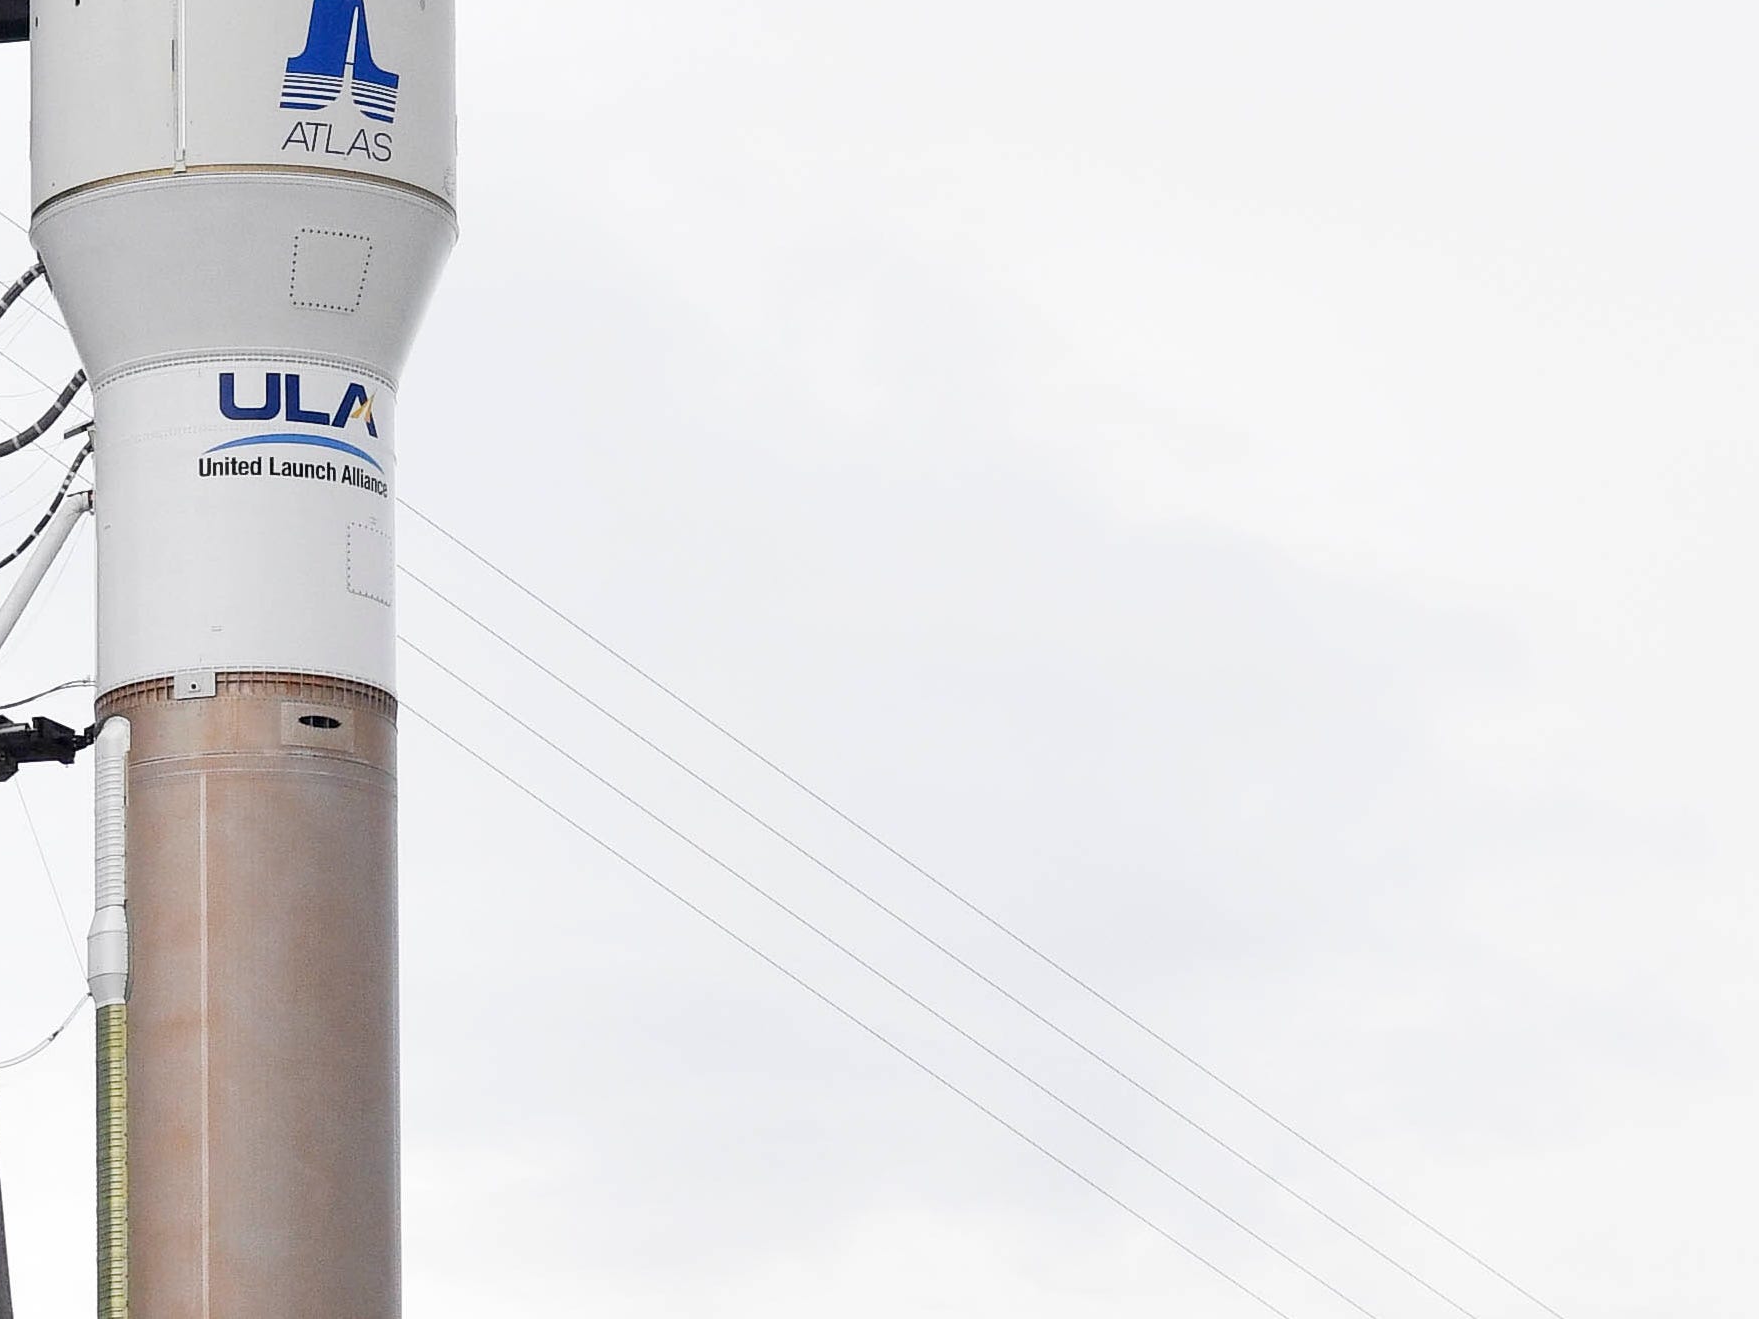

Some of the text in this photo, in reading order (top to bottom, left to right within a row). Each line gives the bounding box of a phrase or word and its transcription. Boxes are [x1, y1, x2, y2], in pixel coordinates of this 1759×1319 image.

[281, 121, 393, 162] ATLAS
[218, 372, 379, 439] ULA
[198, 456, 389, 498] United Launch Alliance
